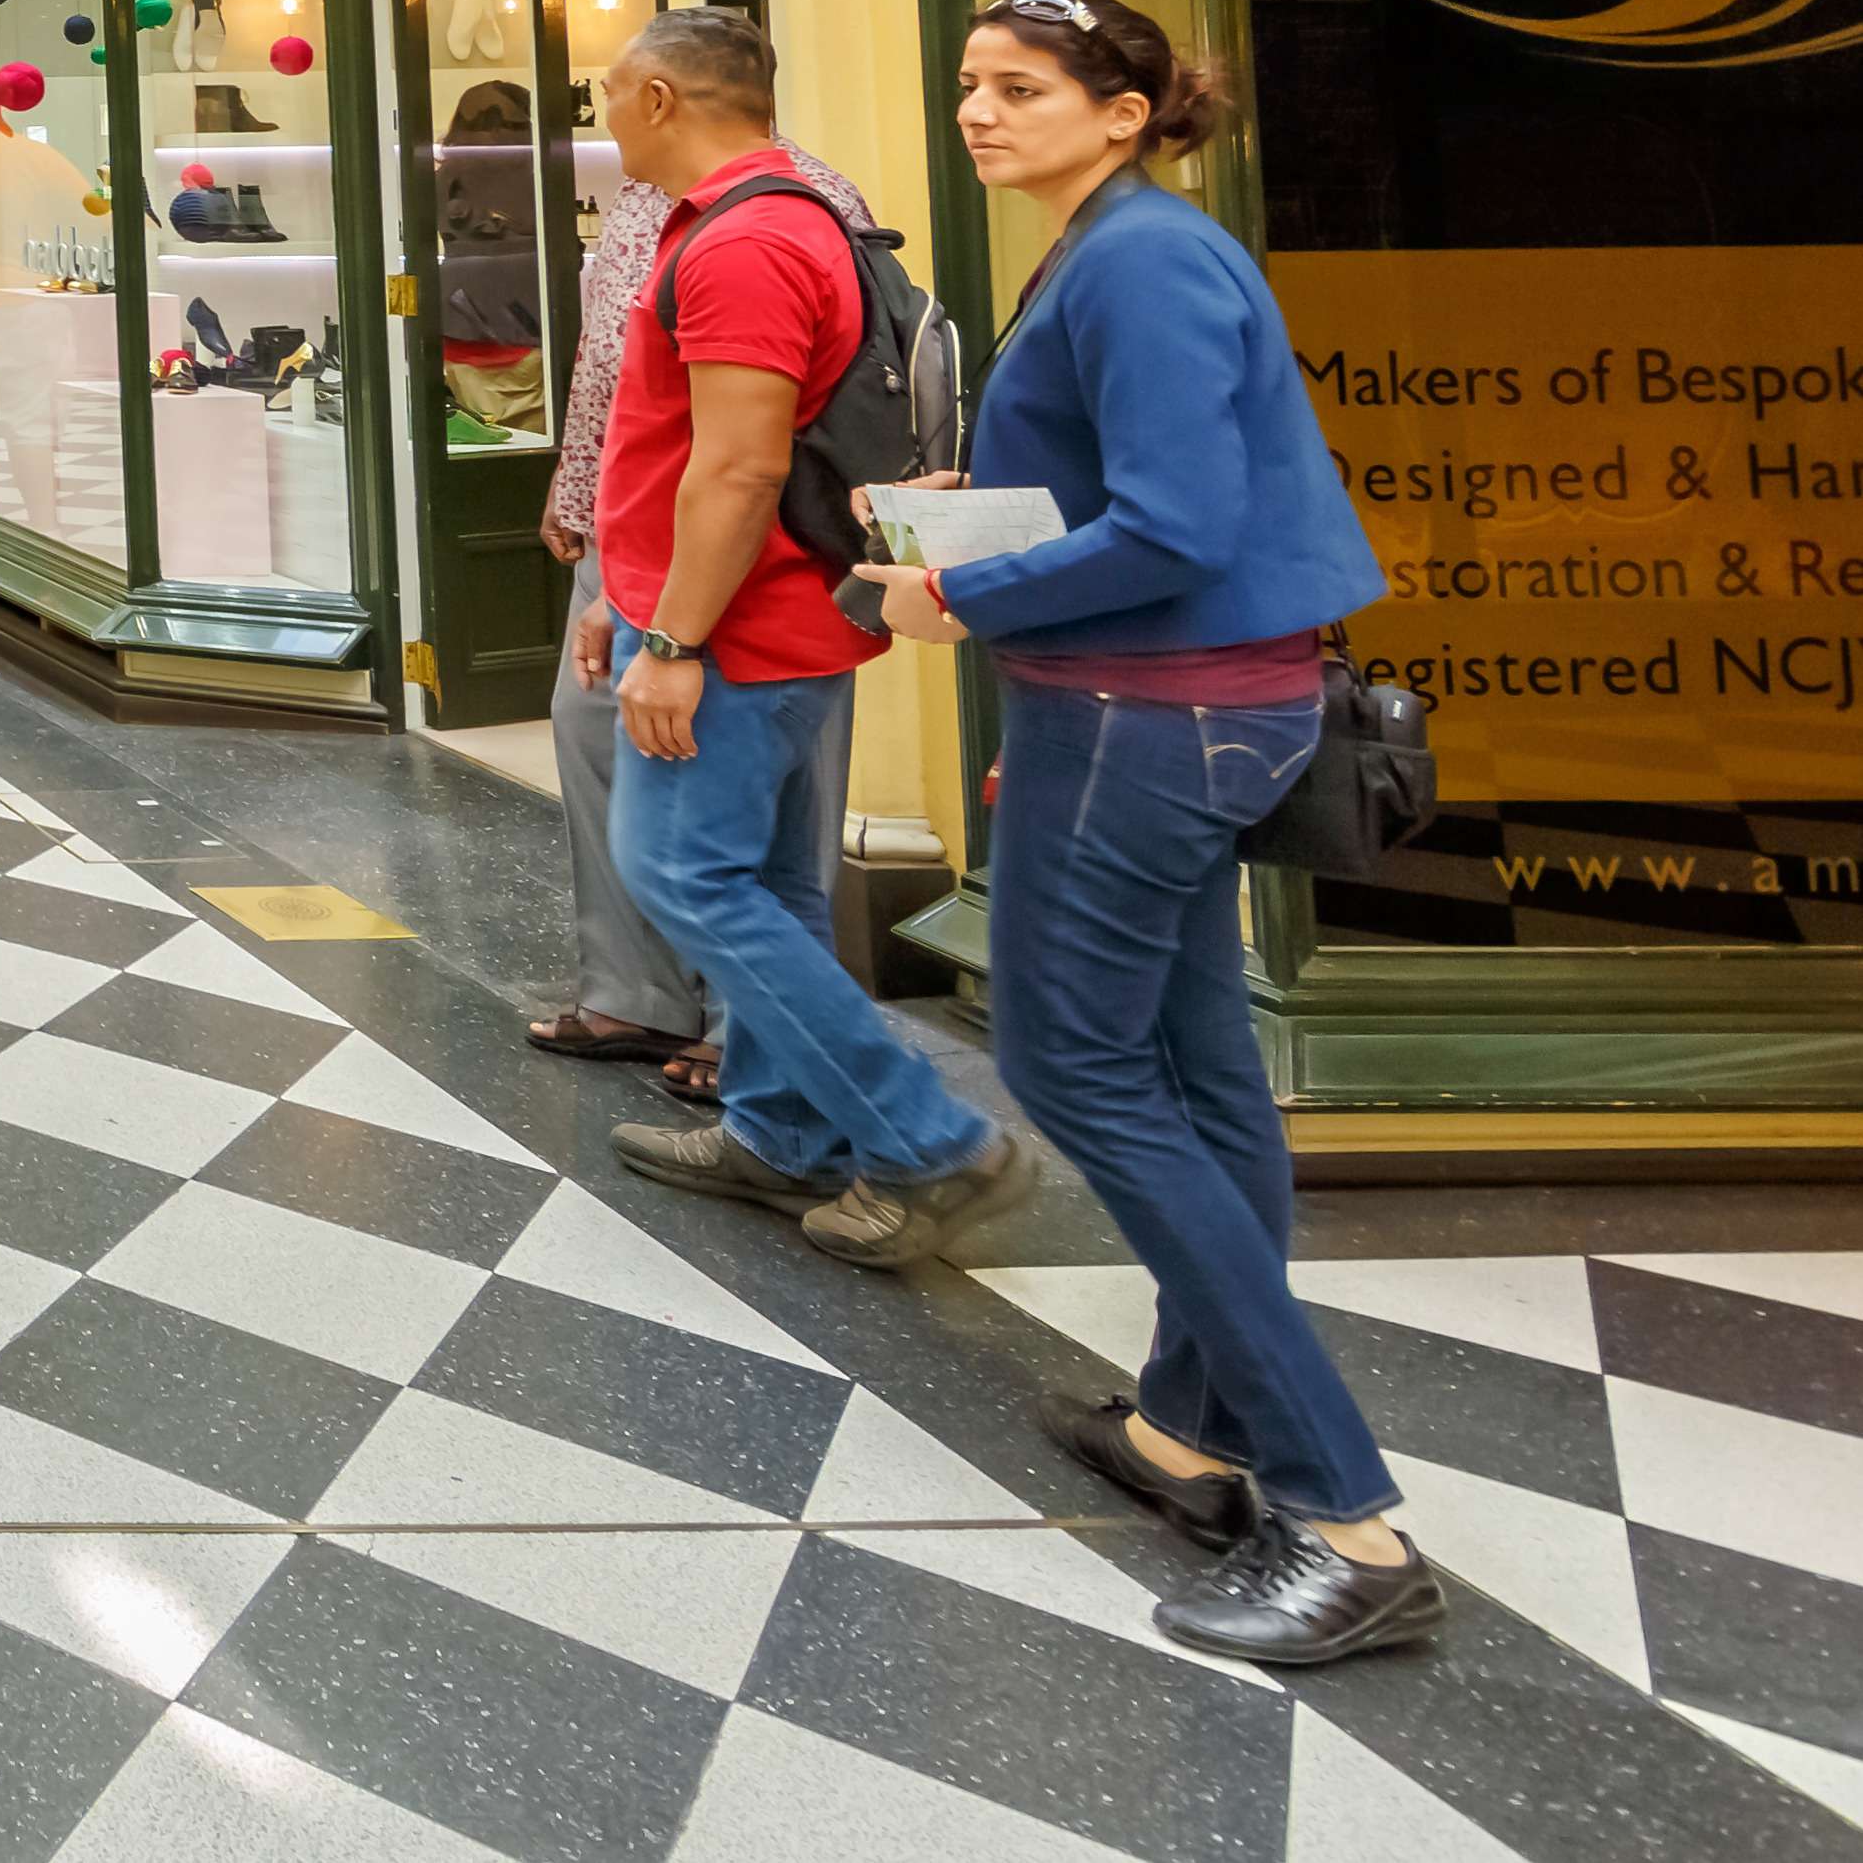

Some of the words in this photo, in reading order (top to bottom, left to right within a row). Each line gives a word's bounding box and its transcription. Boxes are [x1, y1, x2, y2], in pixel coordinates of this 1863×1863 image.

[1296, 349, 1522, 407] Makers
[1549, 340, 1611, 404] of
[1665, 445, 1712, 500] &
[1387, 546, 1689, 600] storation
[1716, 541, 1761, 597] &
[1364, 640, 1676, 712] egistered
[1713, 637, 1863, 710] NCJ
